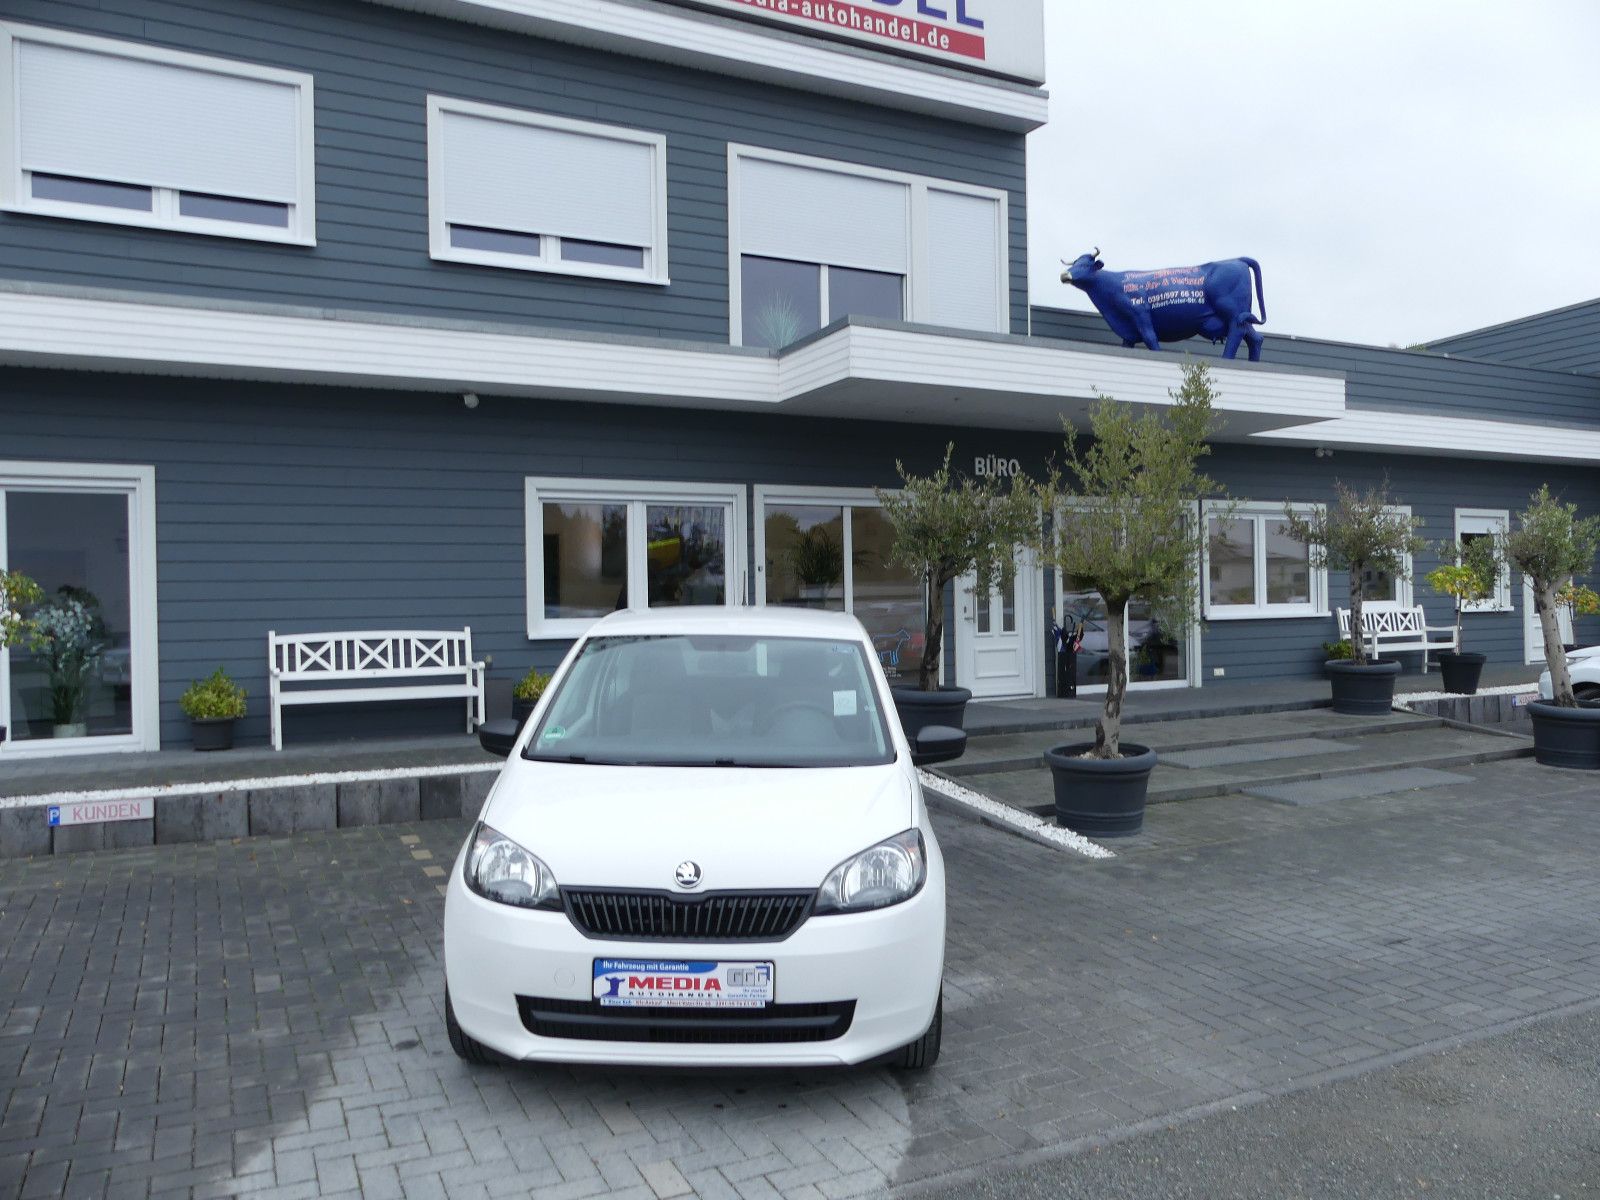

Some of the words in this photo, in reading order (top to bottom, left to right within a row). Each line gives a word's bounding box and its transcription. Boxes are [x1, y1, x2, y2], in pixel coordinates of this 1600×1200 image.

[744, 0, 949, 49] a-autohandel.de
[1131, 296, 1145, 305] Tel.
[975, 454, 1020, 477] BÜRO
[73, 803, 140, 821] KUNDEN
[603, 960, 612, 969] Ihr
[613, 961, 645, 972] Fahrzeug
[659, 963, 689, 971] Garantie
[629, 976, 721, 991] MEDIA
